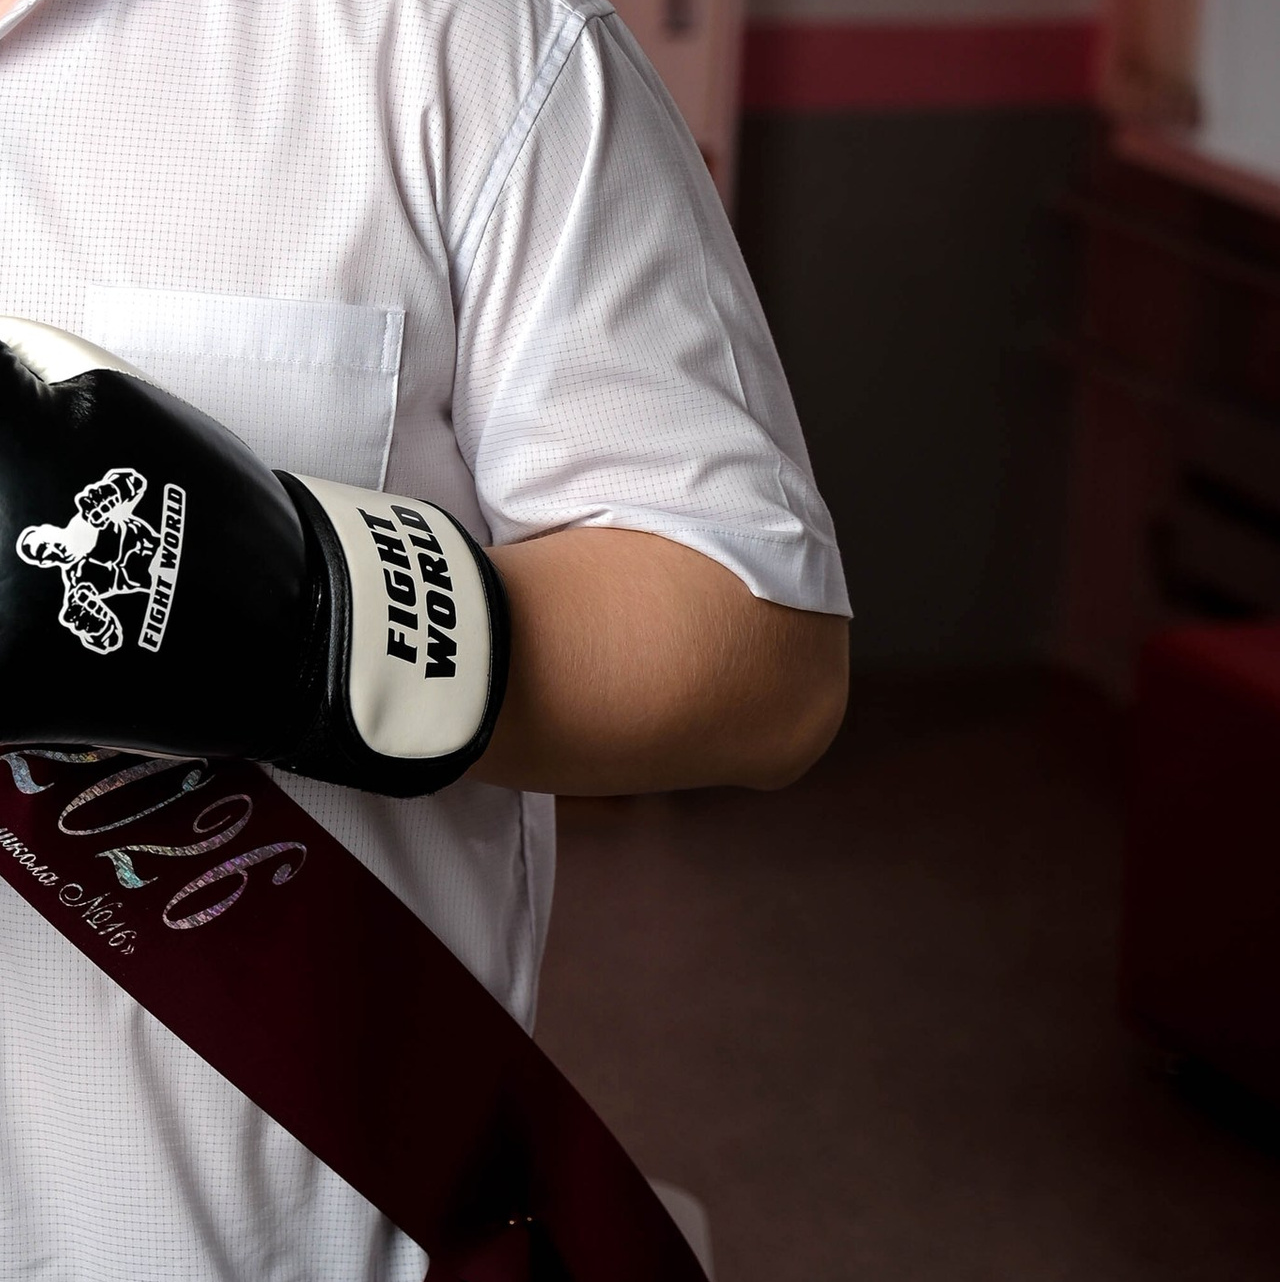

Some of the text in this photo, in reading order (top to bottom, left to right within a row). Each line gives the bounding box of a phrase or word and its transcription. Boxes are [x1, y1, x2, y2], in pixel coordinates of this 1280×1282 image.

[142, 486, 184, 649] FIGHT WORLD
[356, 507, 419, 665] FIGHT
[390, 504, 458, 680] WORLD
